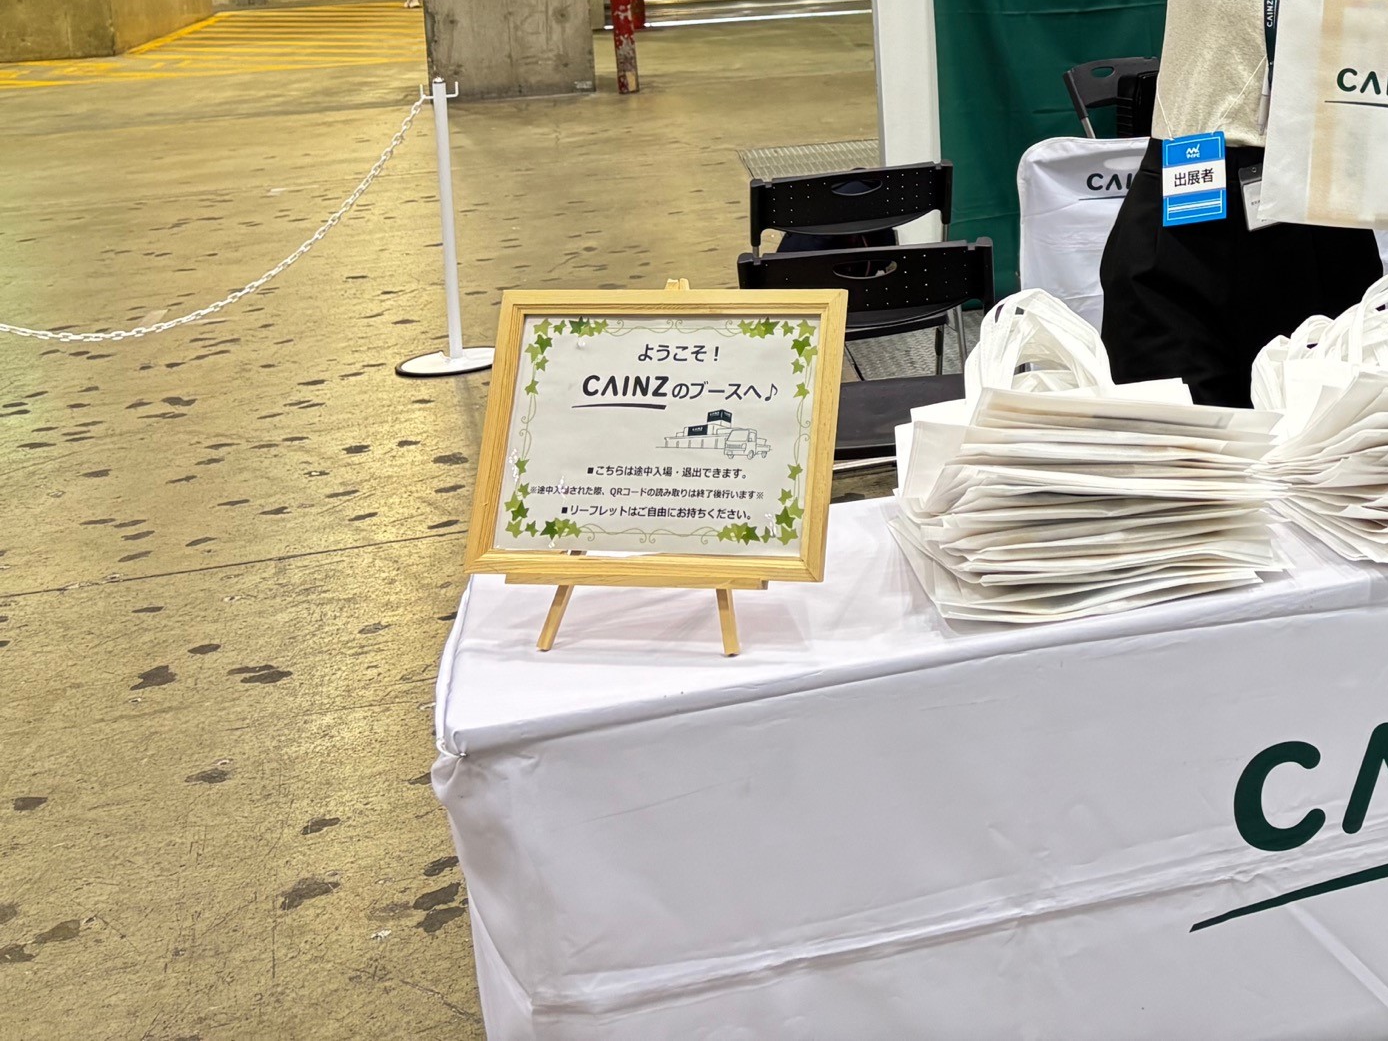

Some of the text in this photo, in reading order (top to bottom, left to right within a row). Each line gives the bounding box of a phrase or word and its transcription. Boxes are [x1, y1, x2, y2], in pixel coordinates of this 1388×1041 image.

[1266, 0, 1274, 28] CAINZ
[1086, 172, 1133, 191] CAI
[1174, 167, 1214, 188] 出展者
